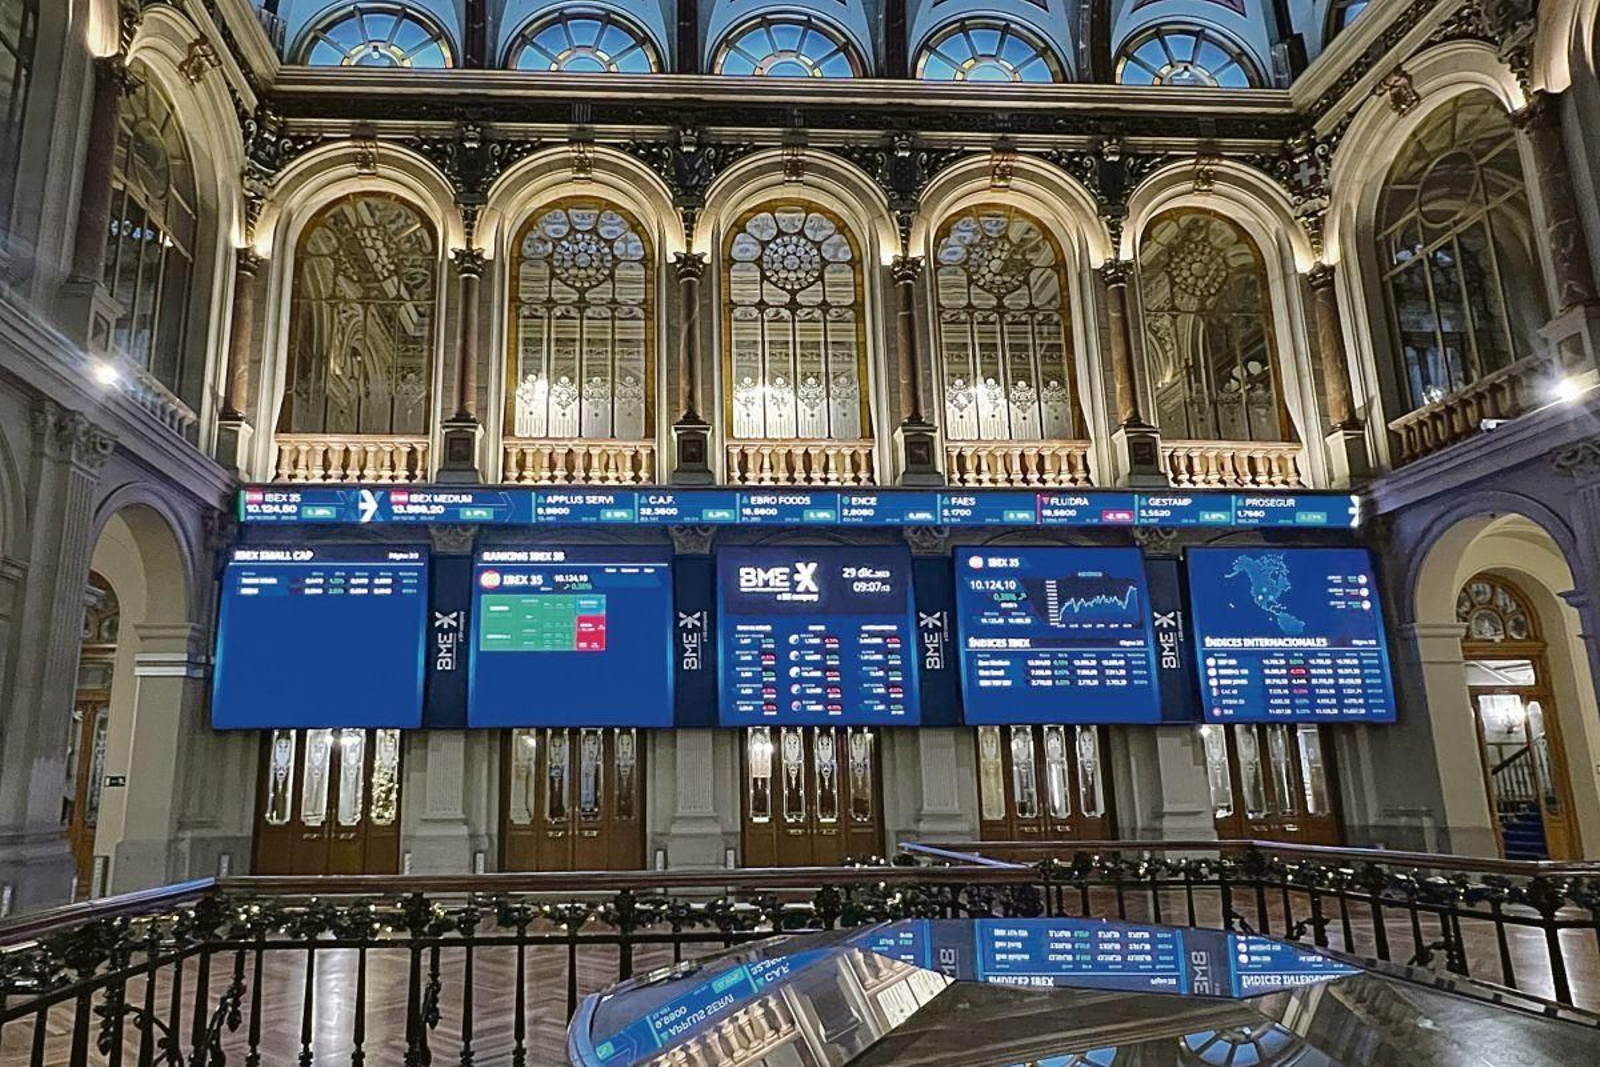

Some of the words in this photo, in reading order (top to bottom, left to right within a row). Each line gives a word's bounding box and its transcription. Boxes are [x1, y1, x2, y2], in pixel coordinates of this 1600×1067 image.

[265, 493, 288, 502] IBEX
[289, 493, 301, 502] 35
[410, 494, 432, 503] IBEX
[433, 494, 472, 503] MEDIUM
[546, 495, 584, 504] APPLUS
[585, 495, 614, 504] SERVI
[648, 495, 675, 504] C.A.F.
[750, 496, 777, 505] EBRO
[778, 496, 811, 505] FOODS
[851, 496, 877, 505] ENCE
[951, 496, 976, 506] FAES
[1050, 497, 1089, 506] FLUIDRA
[1148, 498, 1192, 506] GESTAMP
[1245, 498, 1296, 507] PROSEGUR
[234, 550, 259, 561] IBEX
[260, 550, 292, 561] SMALL
[293, 550, 314, 561] CAP
[482, 552, 529, 561] RANKING
[529, 552, 552, 561] IBEX
[553, 552, 565, 561] 35
[987, 558, 1009, 567] IBEX
[1010, 558, 1020, 567] 35
[739, 567, 790, 588] BME
[842, 567, 857, 578] 29
[502, 574, 529, 585] IBEX
[530, 574, 543, 585] 35
[970, 580, 1016, 591] 10.124,10
[968, 637, 1007, 649] ÍNDICES
[1008, 638, 1031, 649] IBEX
[1204, 636, 1243, 648] ÍNDICES
[1243, 637, 1327, 648] INTERNACIONALES
[436, 632, 454, 671] BME
[682, 632, 698, 670] BME
[923, 632, 941, 669] BME
[1159, 631, 1176, 669] BME
